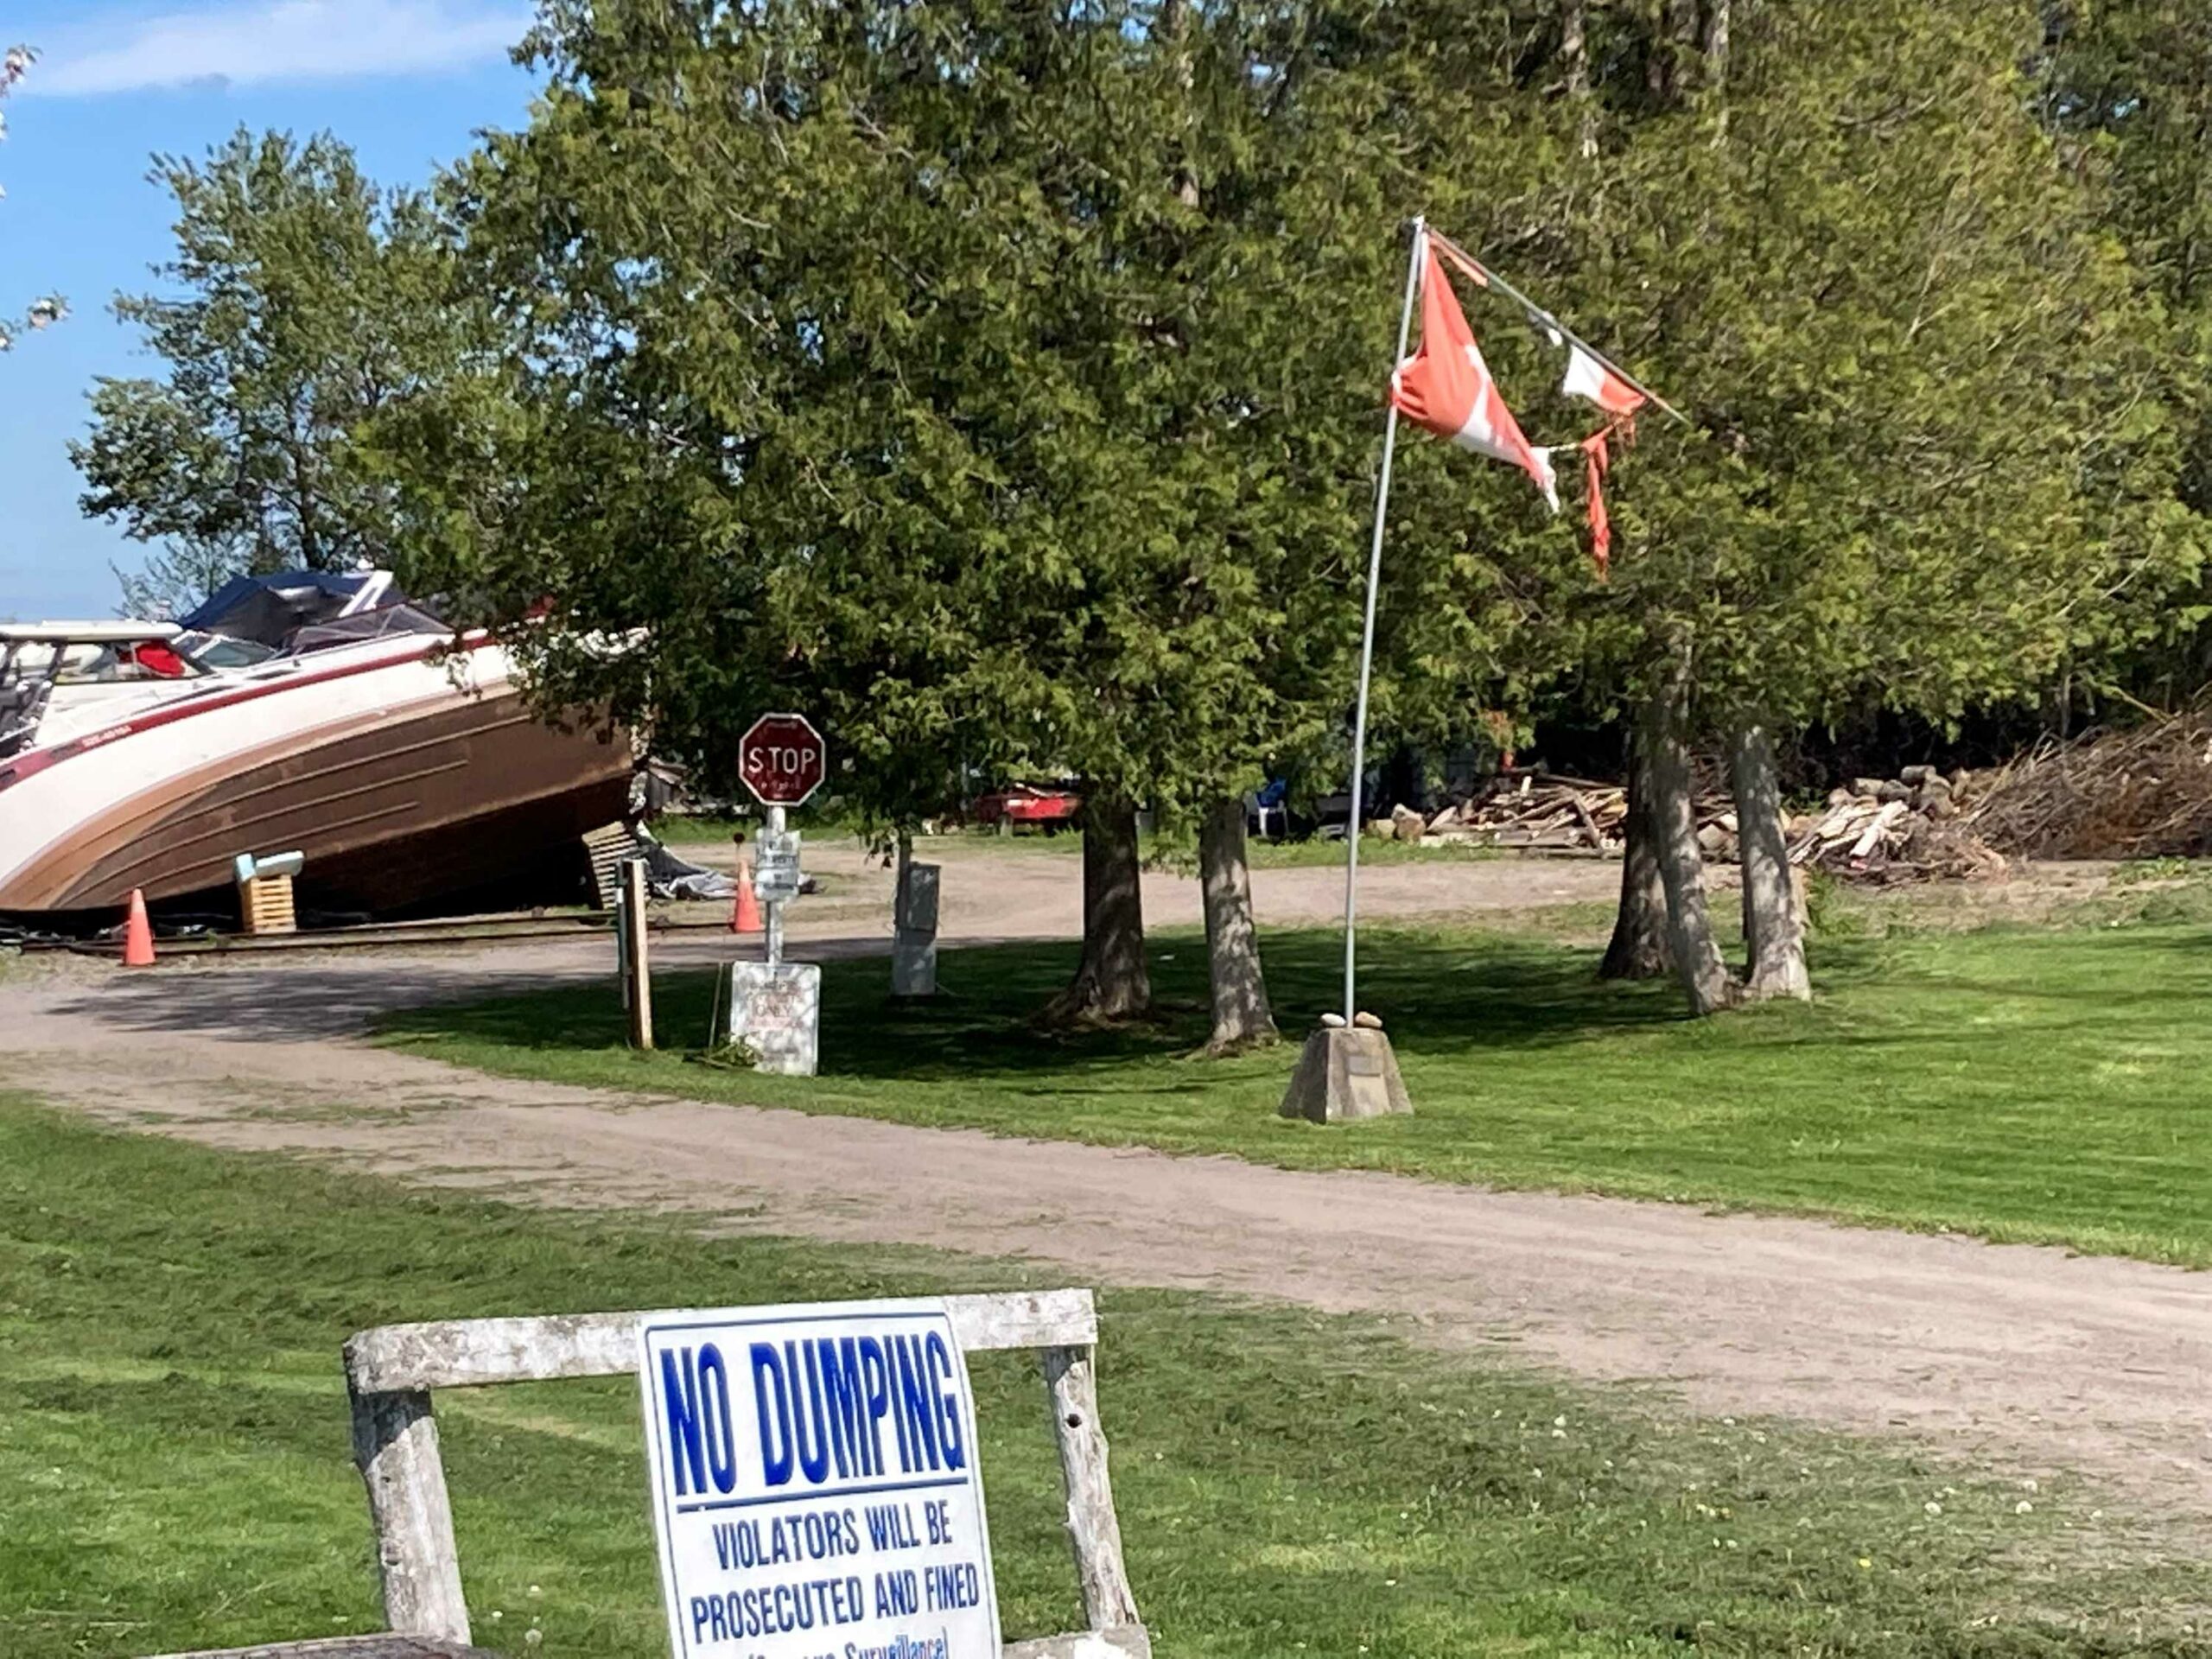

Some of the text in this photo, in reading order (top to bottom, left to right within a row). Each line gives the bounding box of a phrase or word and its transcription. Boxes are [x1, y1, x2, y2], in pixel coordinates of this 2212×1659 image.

[748, 747, 817, 774] STOP
[659, 1330, 967, 1497] NO DUMPING
[712, 1499, 953, 1571] VIOLATORS WILL BE
[690, 1562, 980, 1644] PROSECUTED AND FINED
